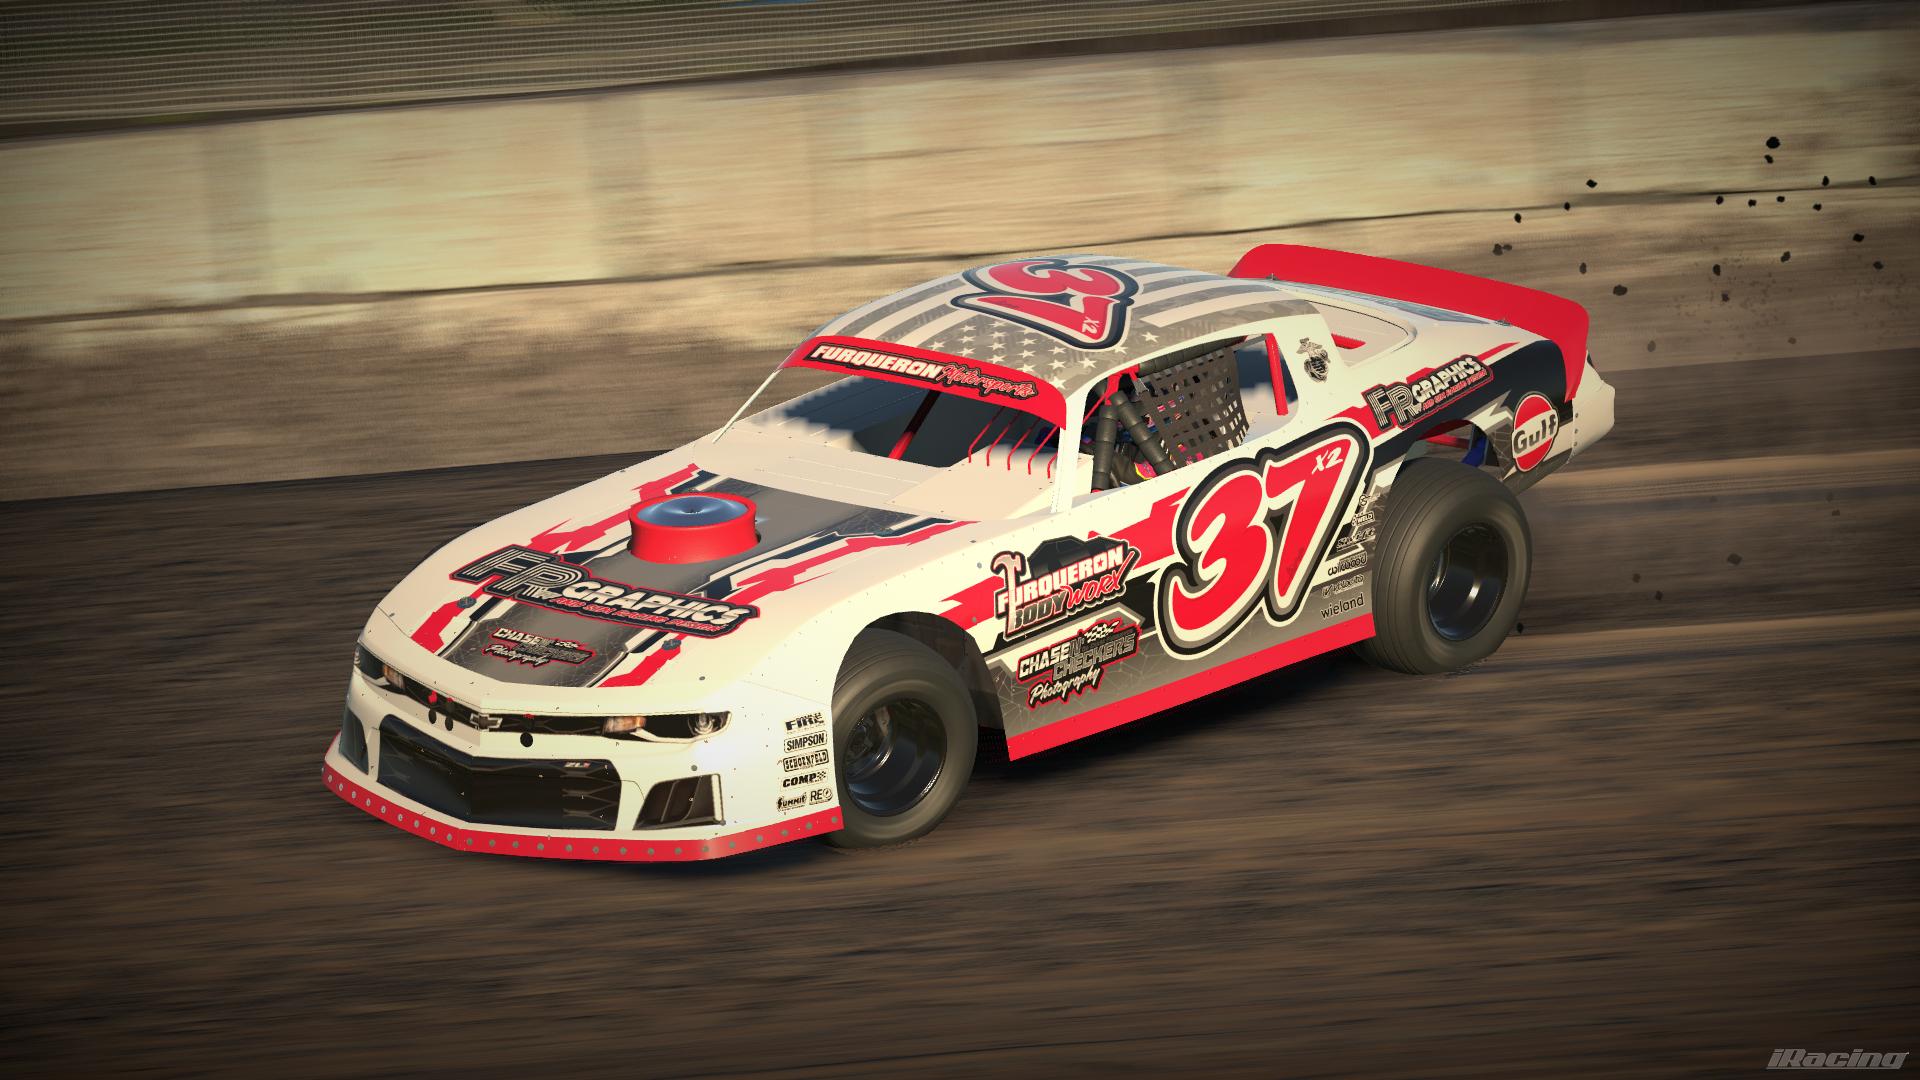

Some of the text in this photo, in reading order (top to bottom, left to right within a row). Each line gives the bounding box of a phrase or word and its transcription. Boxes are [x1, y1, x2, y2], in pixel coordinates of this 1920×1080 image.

[963, 260, 1128, 344] 37
[811, 344, 1035, 396] FURQUERON Motorsports
[1411, 357, 1482, 404] GRAPHICS
[1513, 413, 1557, 455] Gulf
[1165, 432, 1360, 646] 37 X2
[997, 545, 1124, 615] FURQUERON
[1328, 553, 1367, 577] wilwood
[562, 580, 751, 626] GRAPHICS
[1321, 593, 1365, 619] wieland
[1053, 632, 1136, 681] CHECKERS
[1030, 667, 1101, 705] Photography
[785, 752, 828, 770] SCHOENFELD
[787, 732, 825, 751] SIMPSON
[783, 772, 817, 788] COMP
